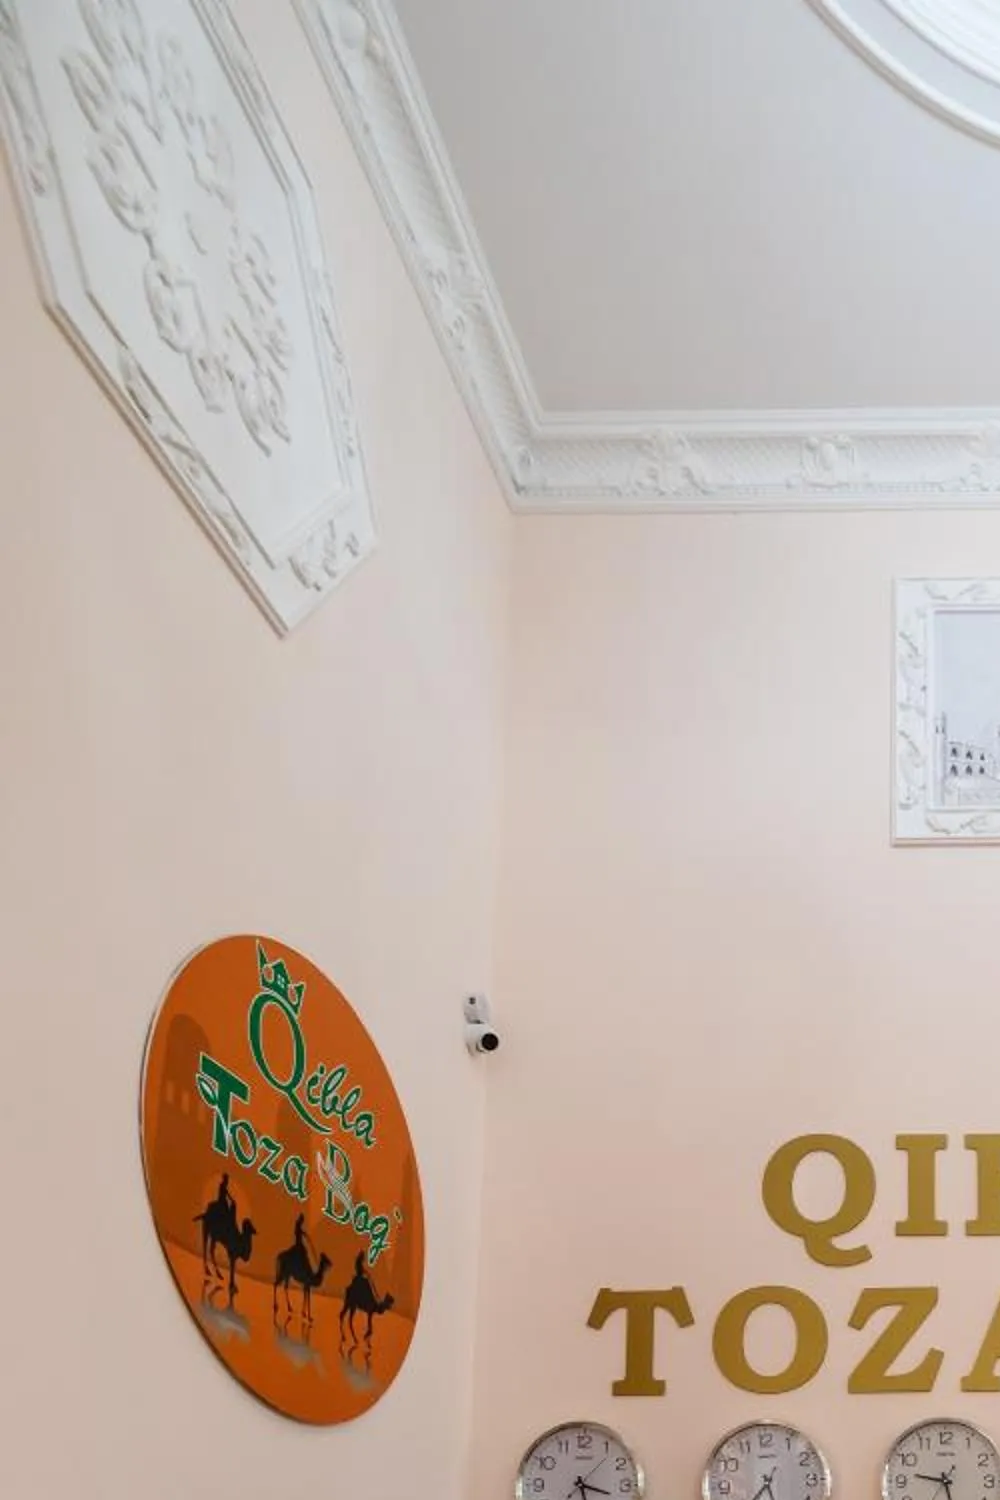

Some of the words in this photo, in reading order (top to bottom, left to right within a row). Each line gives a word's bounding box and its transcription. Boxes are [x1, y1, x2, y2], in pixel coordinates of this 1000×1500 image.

[247, 988, 377, 1149] Qibla
[195, 1051, 308, 1201] Toza
[575, 1434, 593, 1450] 12
[758, 1432, 773, 1448] 12
[785, 1437, 791, 1451] 1
[916, 1436, 931, 1451] 11
[939, 1431, 954, 1445] 12
[965, 1436, 971, 1450] 1
[557, 1439, 570, 1456] 11
[604, 1439, 610, 1454] 1
[739, 1440, 751, 1454] 11
[534, 1455, 557, 1471] 10
[615, 1456, 627, 1471] 2
[799, 1451, 811, 1467] 2
[895, 1451, 918, 1468] 10
[977, 1453, 989, 1468] 2
[532, 1477, 545, 1493] 9
[805, 1472, 818, 1488] 3
[895, 1473, 907, 1489] 9
[983, 1473, 995, 1489] 3
